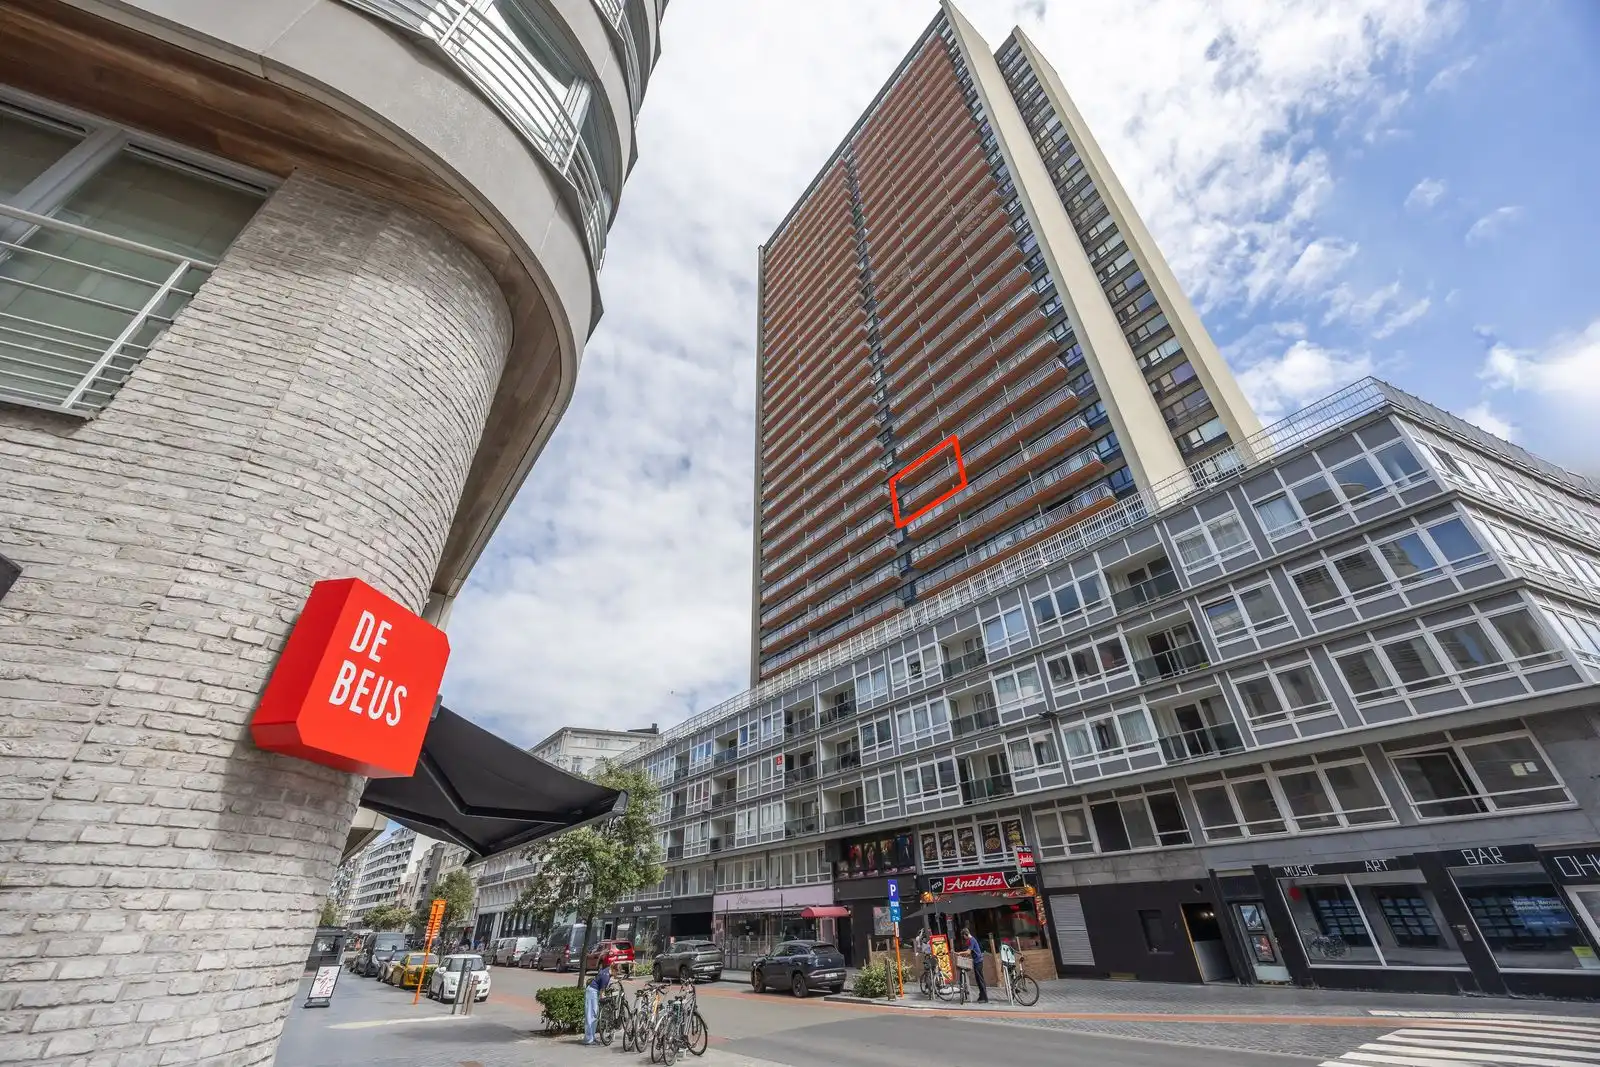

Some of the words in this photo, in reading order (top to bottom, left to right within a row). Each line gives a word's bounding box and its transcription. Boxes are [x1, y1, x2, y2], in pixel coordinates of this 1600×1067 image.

[349, 609, 392, 663] DE
[328, 659, 408, 727] BEUS
[1461, 847, 1507, 865] BAR
[1283, 865, 1318, 877] MUSIC
[1364, 859, 1389, 872] ART
[889, 884, 897, 896] P
[946, 875, 1003, 891] Anatolia
